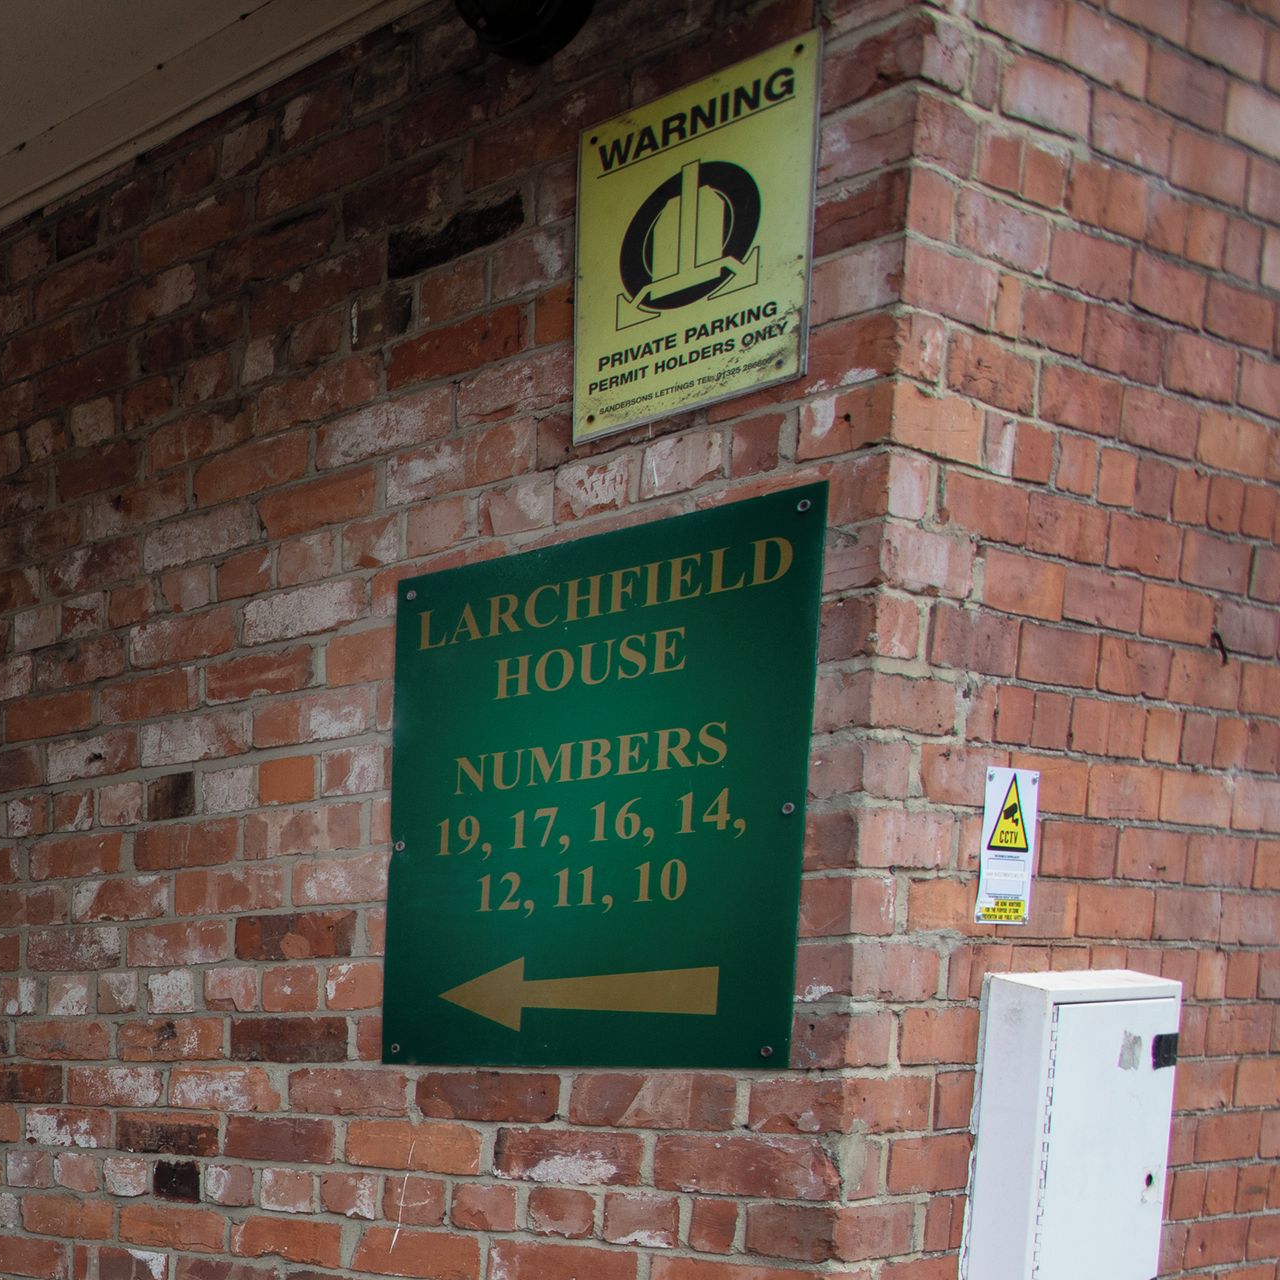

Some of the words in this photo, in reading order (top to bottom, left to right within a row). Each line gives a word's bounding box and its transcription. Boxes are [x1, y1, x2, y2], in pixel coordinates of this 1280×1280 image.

[597, 67, 795, 172] WARNING
[588, 366, 649, 395] PERMIT
[654, 338, 736, 375] HOLDERS
[740, 321, 789, 348] ONLY
[598, 333, 678, 372] PRIVATE
[684, 301, 778, 344] PARKING
[599, 392, 653, 415] SANDERSONS
[654, 381, 695, 398] LETTINGS
[417, 536, 794, 652] LARCHFIELD
[494, 626, 687, 701] HOUSE
[453, 721, 729, 796] NUMBERS
[435, 814, 493, 859] 19,
[510, 806, 571, 855] 17,
[590, 797, 656, 849] 16,
[676, 787, 747, 838] 14,
[999, 830, 1018, 845] CCTV
[476, 871, 536, 918] 12,
[552, 865, 614, 913] 11,
[633, 859, 688, 903] 10
